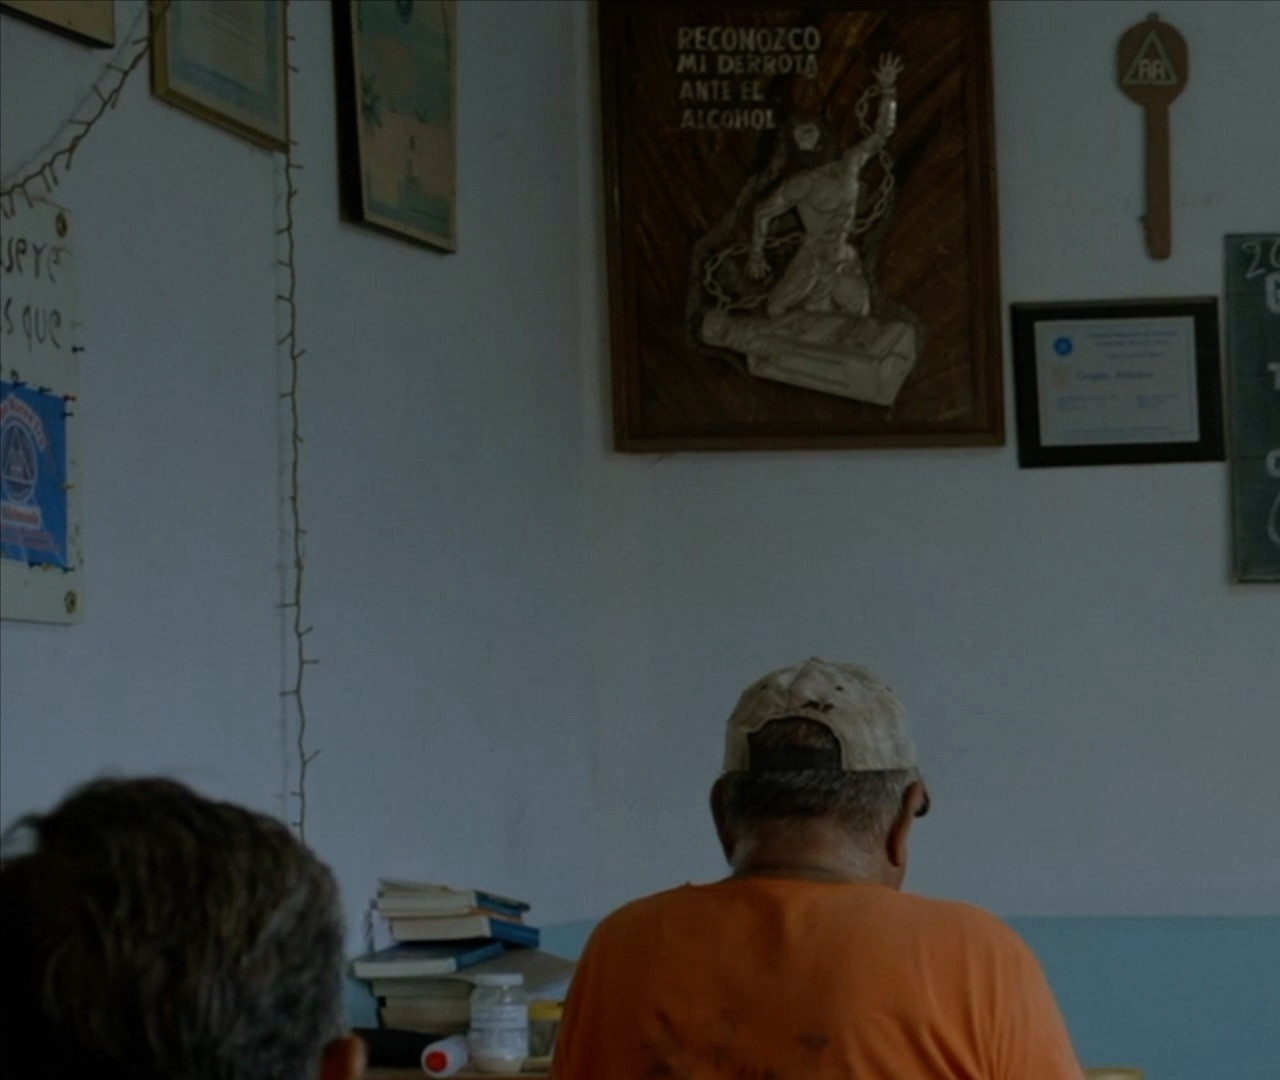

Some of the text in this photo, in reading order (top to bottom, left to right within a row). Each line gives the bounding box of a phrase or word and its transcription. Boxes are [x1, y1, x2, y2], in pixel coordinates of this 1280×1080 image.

[677, 25, 821, 52] RECONOZCO
[676, 53, 819, 79] MI DERROTA
[679, 79, 766, 102] ANTE EL
[680, 107, 776, 130] ALCOHOL
